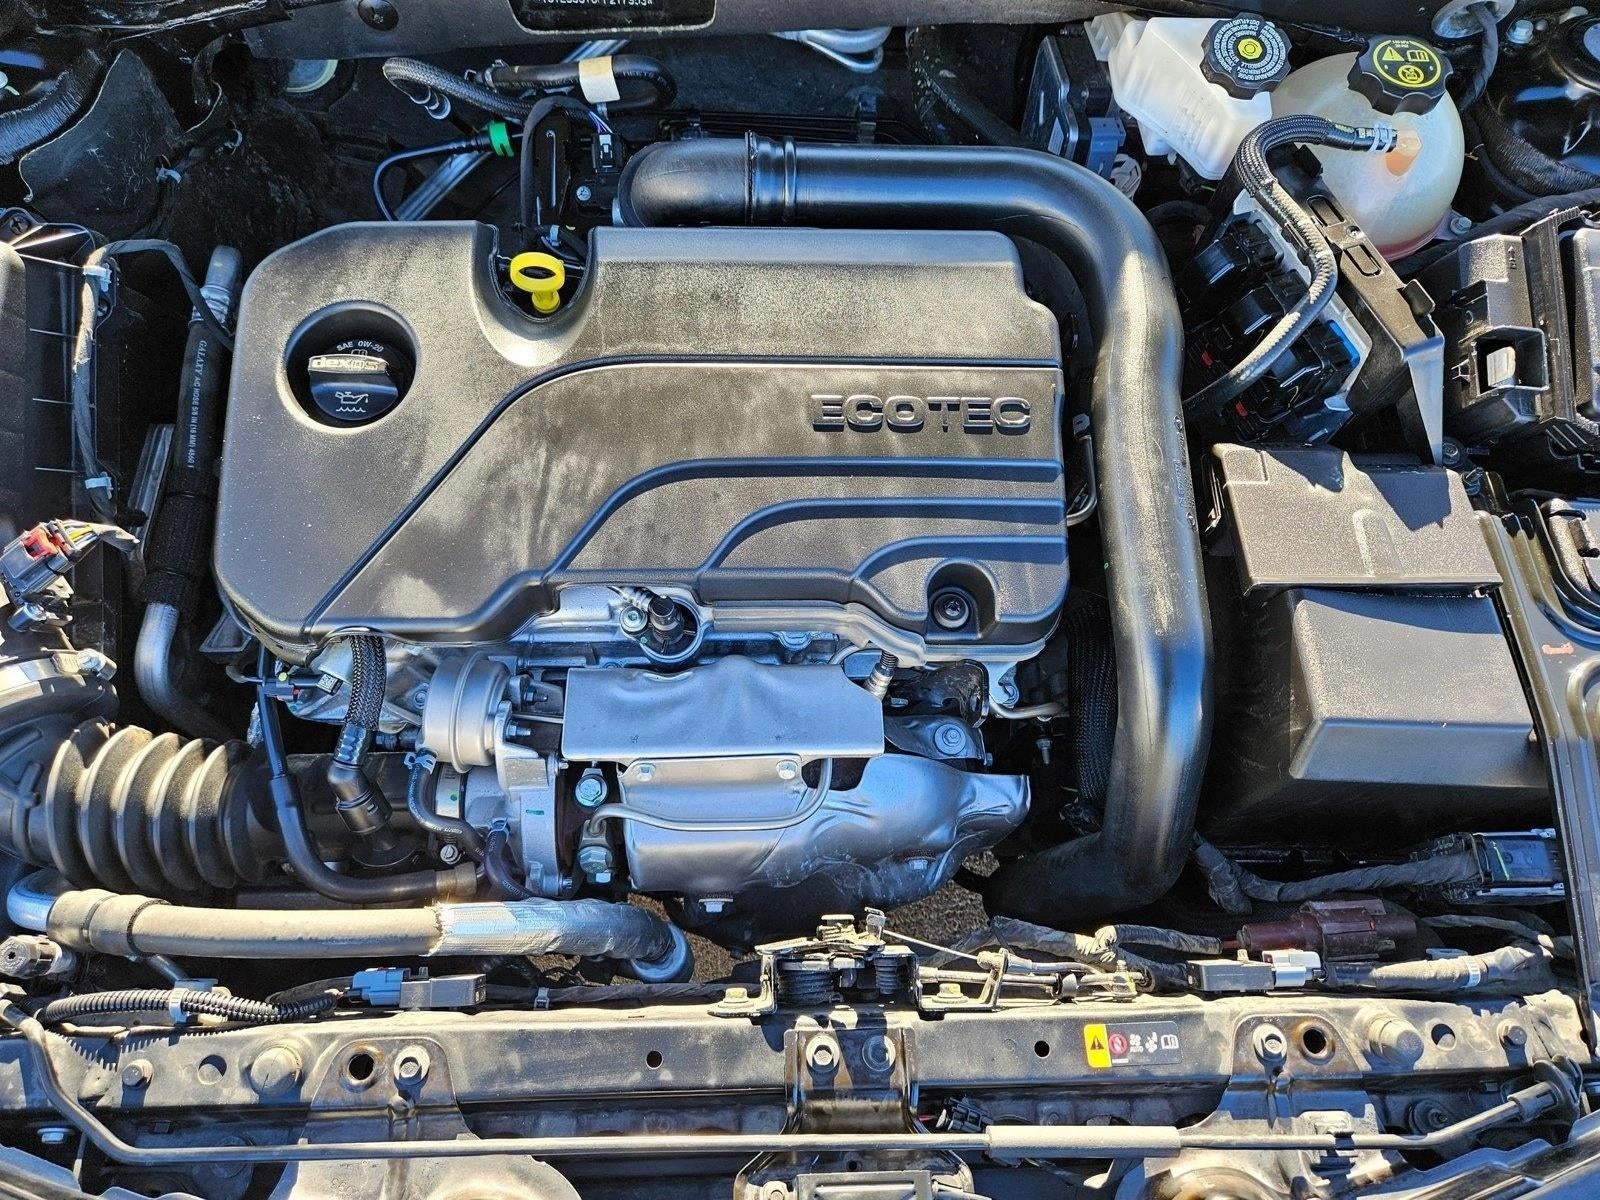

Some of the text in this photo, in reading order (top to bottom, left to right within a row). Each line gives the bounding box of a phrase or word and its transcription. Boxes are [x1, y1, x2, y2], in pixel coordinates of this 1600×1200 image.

[1214, 32, 1222, 49] SEALED
[336, 340, 384, 352] SAE 0W-20
[195, 340, 208, 375] GALAXY
[311, 356, 379, 370] dexos
[193, 377, 202, 388] A/C
[192, 388, 200, 405] HOSE
[811, 394, 1031, 435] ECOTEC
